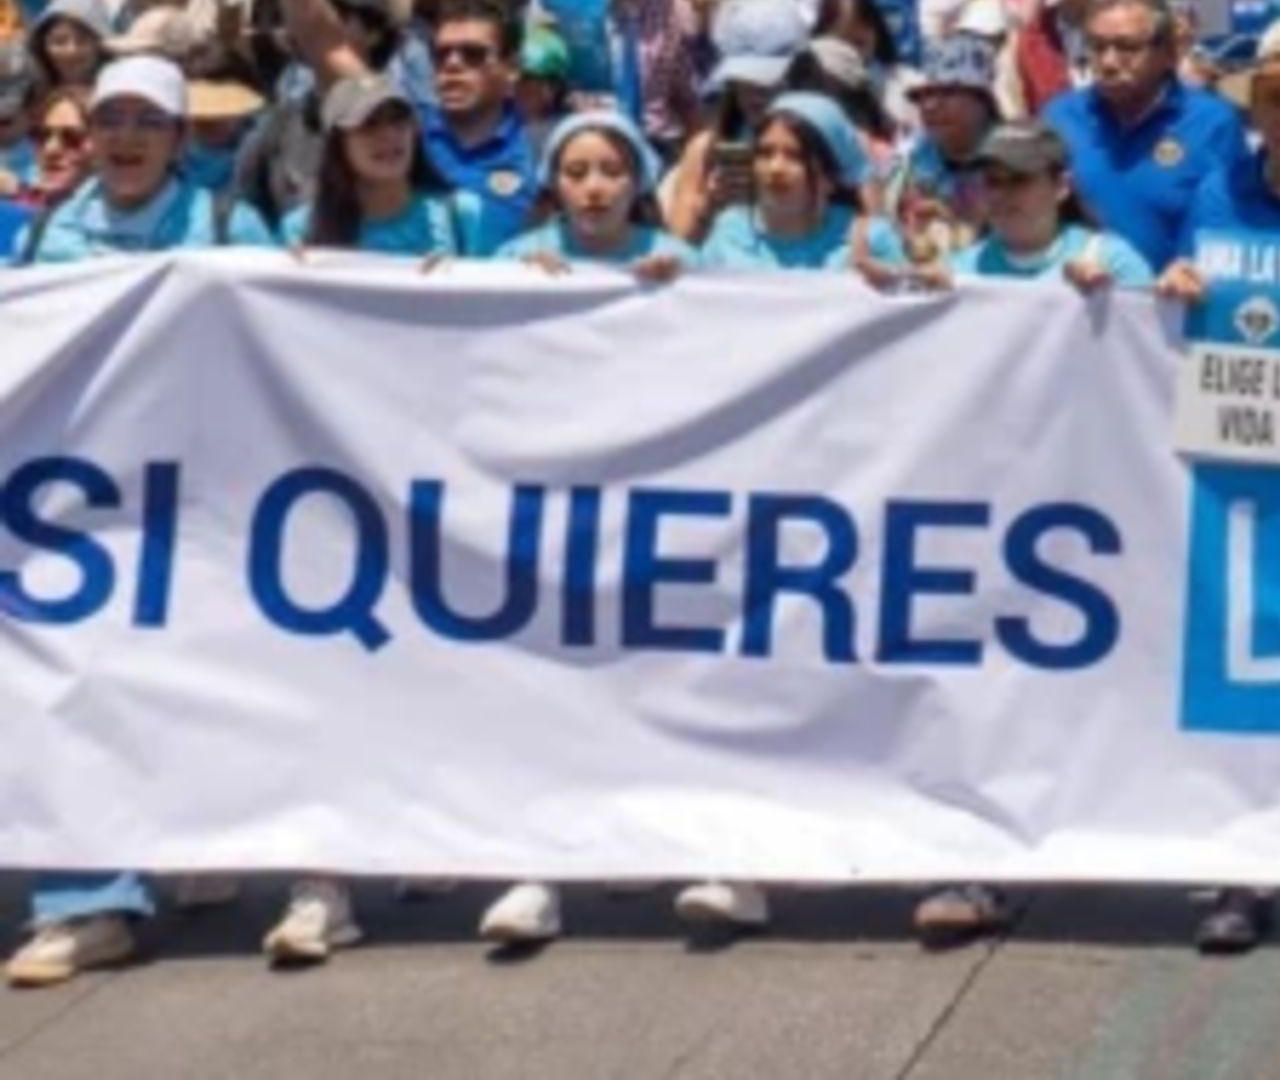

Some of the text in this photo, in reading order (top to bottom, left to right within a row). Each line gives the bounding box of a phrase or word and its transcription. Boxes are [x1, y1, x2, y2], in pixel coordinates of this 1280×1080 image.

[1201, 353, 1264, 398] ELIGE
[1217, 405, 1275, 447] VIDA
[0, 455, 181, 629] SI
[245, 465, 1123, 672] QUIERES
